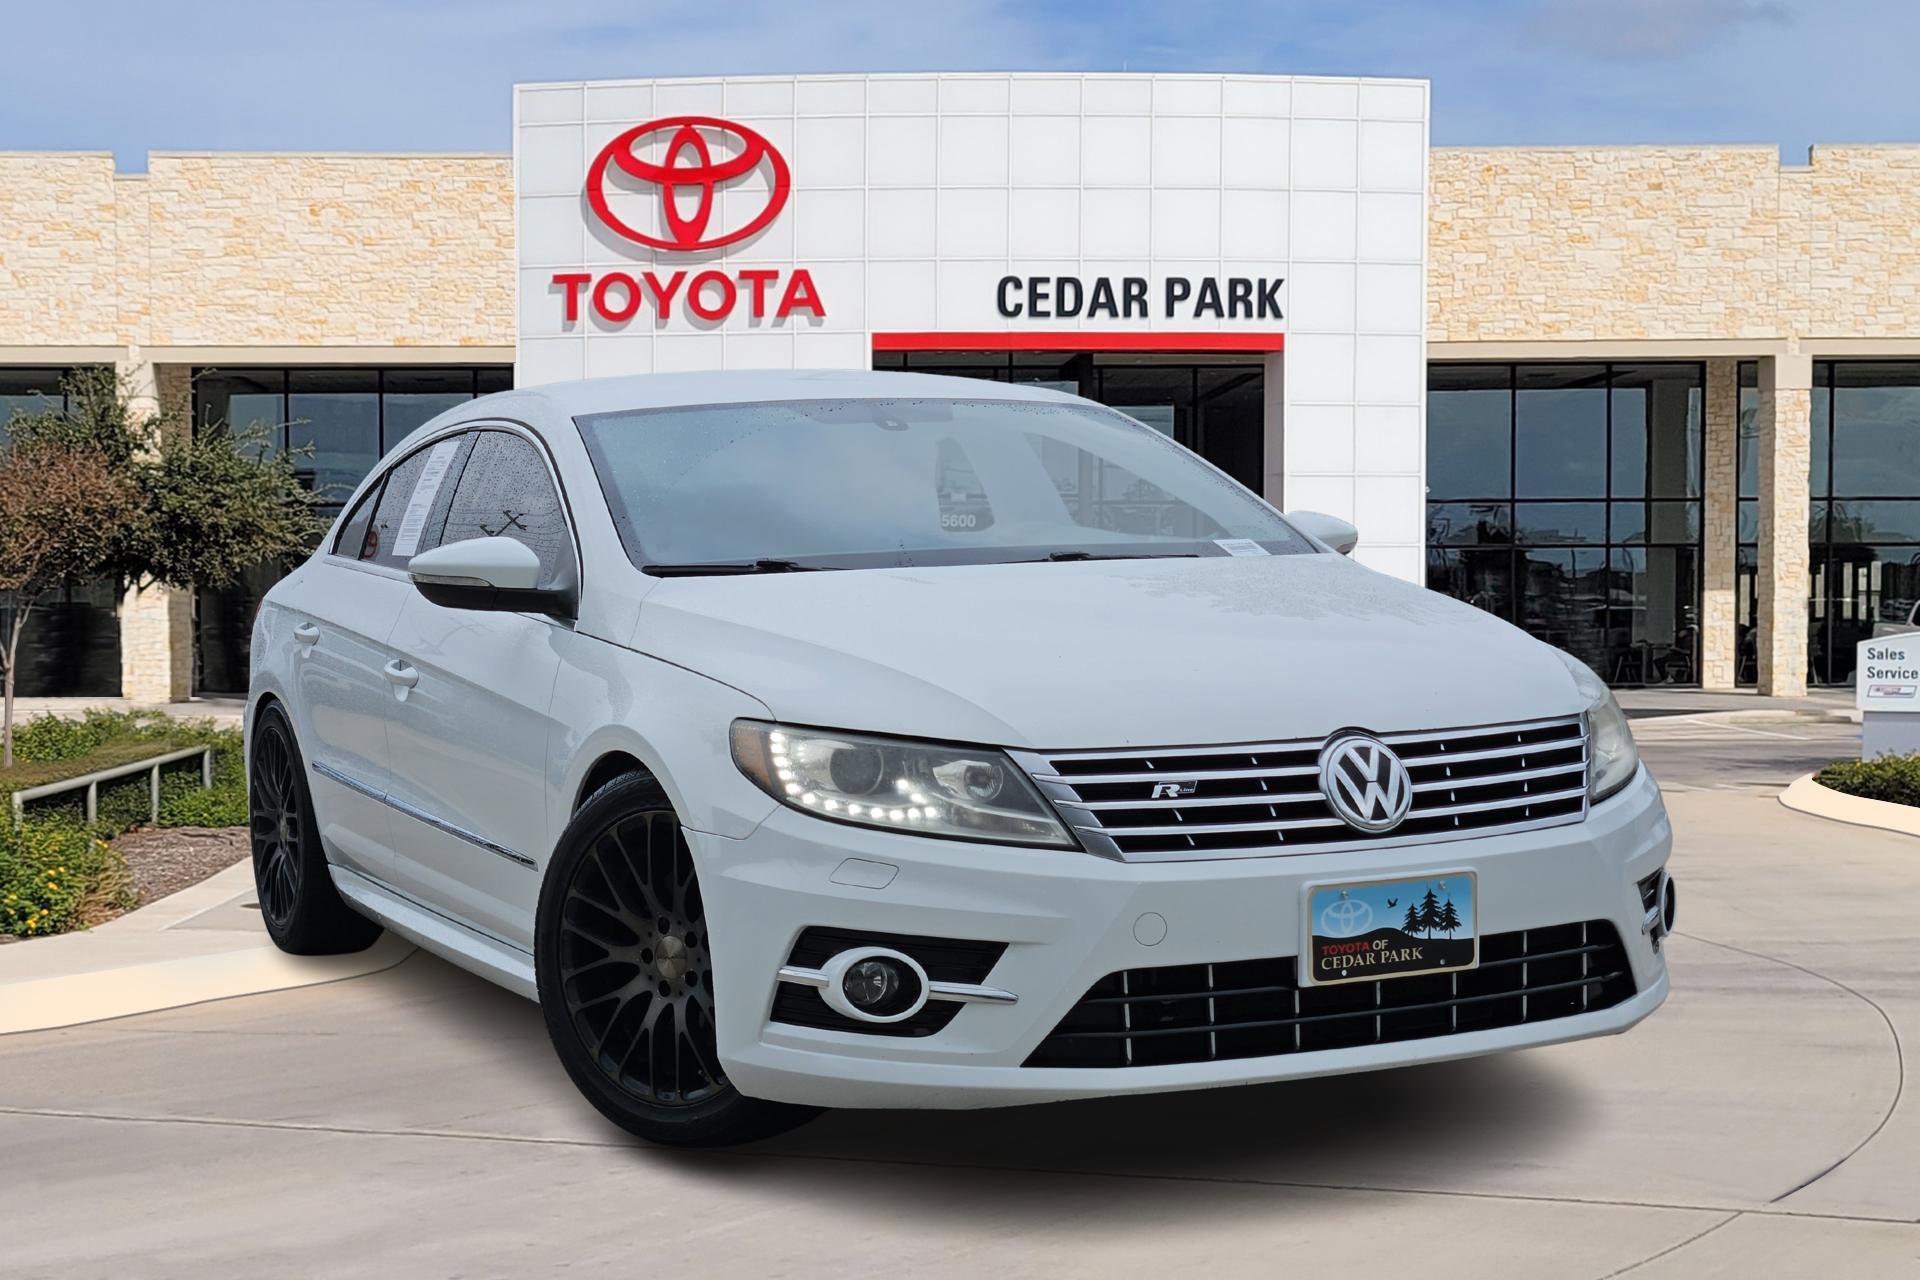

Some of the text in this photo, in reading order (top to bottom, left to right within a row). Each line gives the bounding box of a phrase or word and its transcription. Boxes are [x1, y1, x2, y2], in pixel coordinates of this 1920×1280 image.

[552, 269, 827, 323] TOYOTA
[996, 275, 1285, 319] CEDAR PARK
[942, 514, 976, 527] 5600
[1867, 647, 1905, 660] Sales
[1867, 666, 1918, 679] Service
[1322, 940, 1388, 955] TOYOTA OF
[1321, 947, 1423, 970] CEDAR PARK
